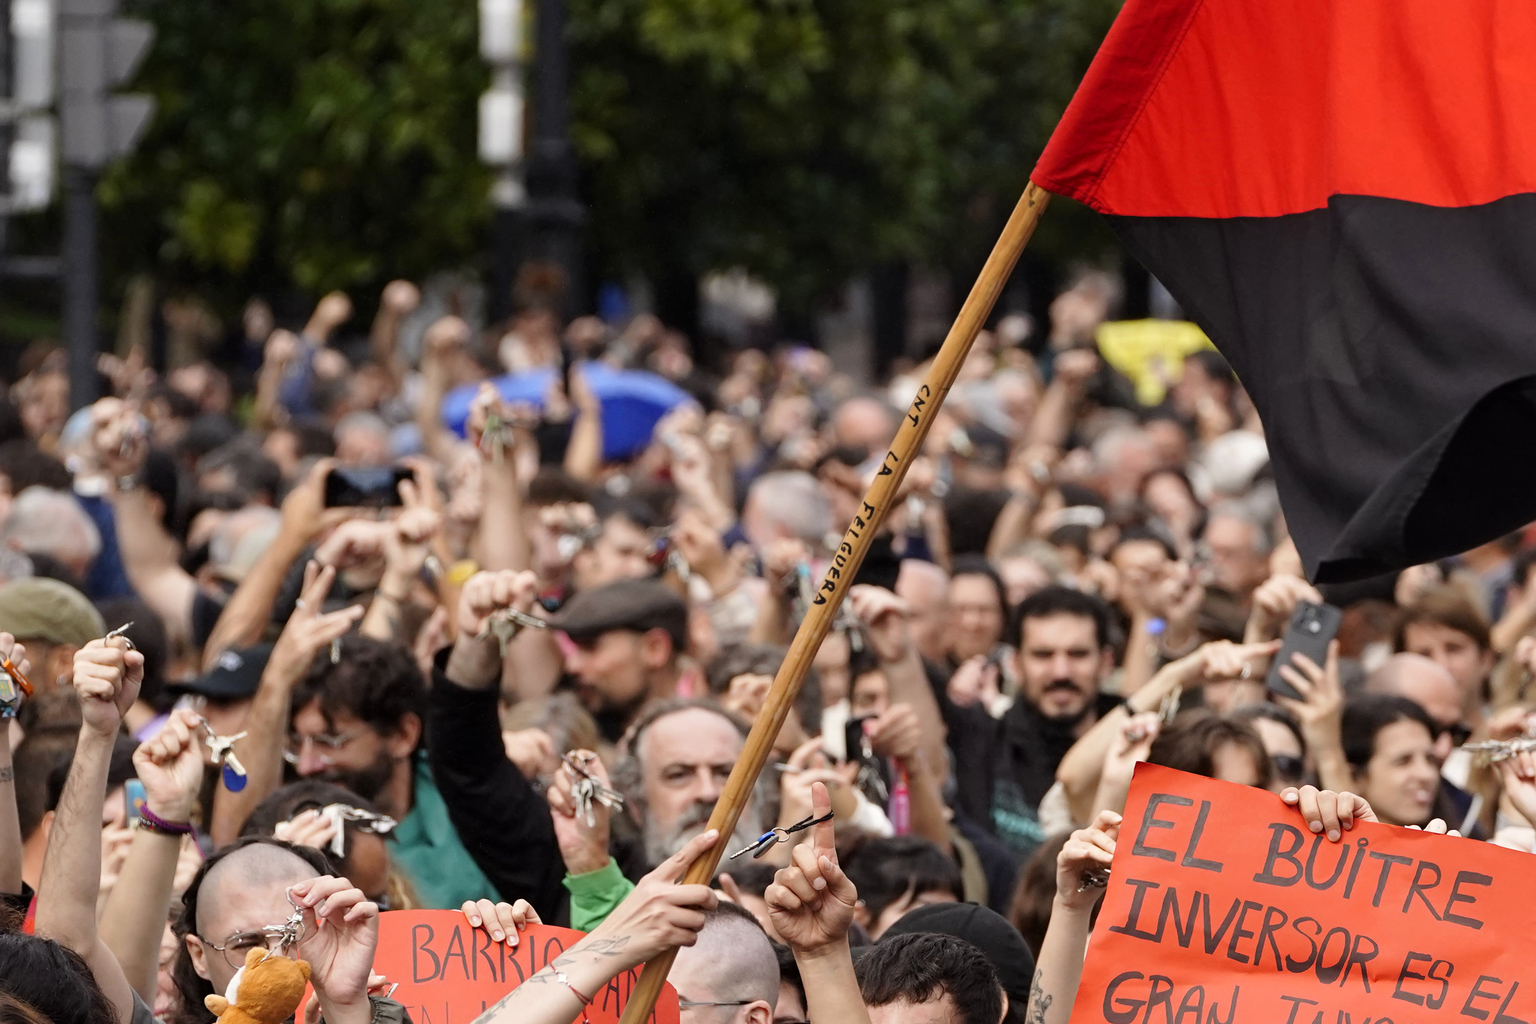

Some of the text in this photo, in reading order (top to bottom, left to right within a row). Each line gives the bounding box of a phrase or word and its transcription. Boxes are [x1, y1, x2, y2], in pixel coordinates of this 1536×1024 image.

[813, 384, 931, 606] CNT LA FELGUERA
[1132, 793, 1223, 873] EL
[1109, 878, 1379, 993] INVERSOR
[1391, 953, 1454, 1010] ES
